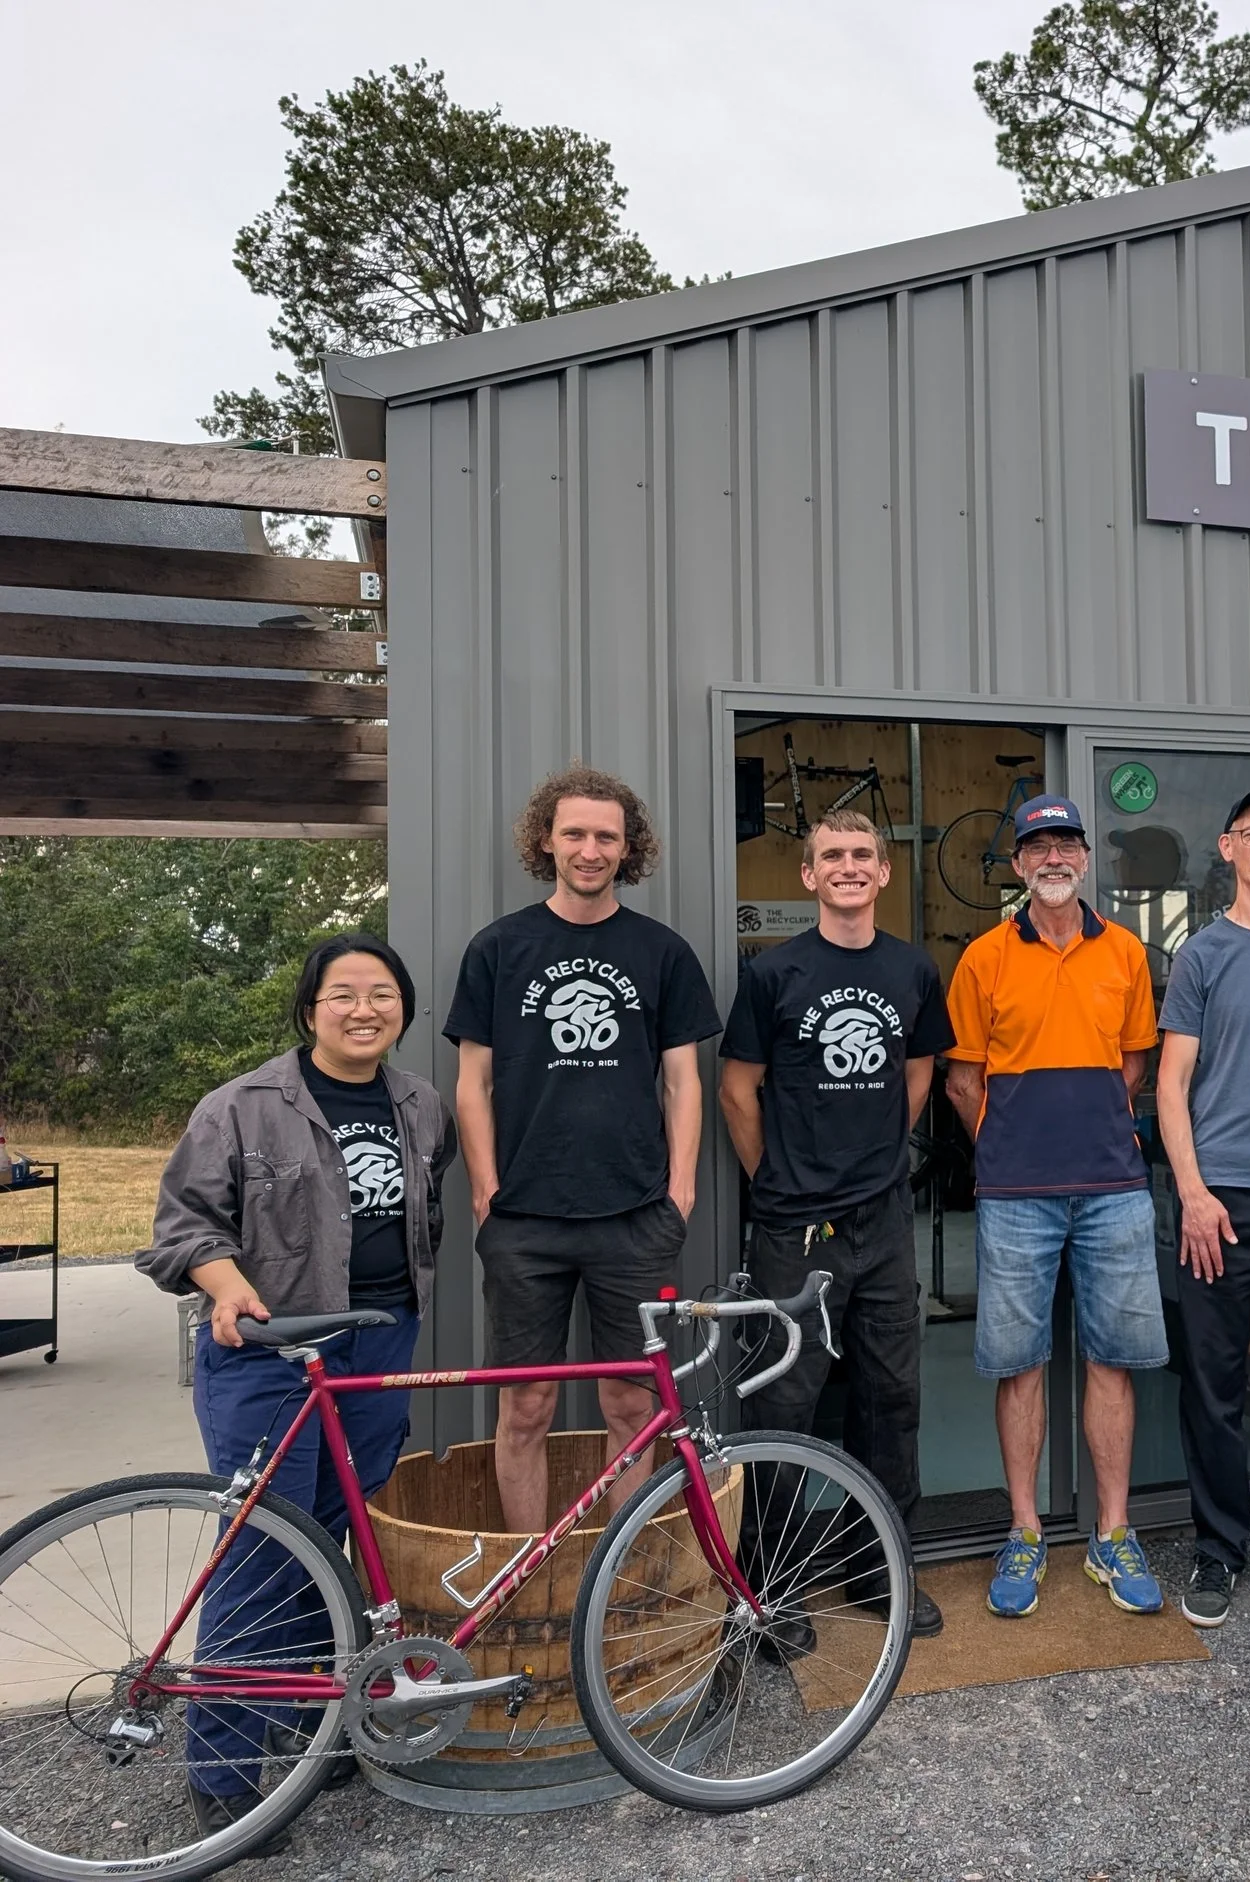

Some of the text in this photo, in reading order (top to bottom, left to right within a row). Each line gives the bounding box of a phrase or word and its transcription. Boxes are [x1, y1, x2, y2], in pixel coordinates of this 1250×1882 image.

[787, 748, 801, 803] CARRERA
[1112, 769, 1133, 793] GREEN
[1114, 772, 1139, 799] WHEELS
[1026, 808, 1069, 822] unisport
[767, 916, 816, 924] RECYCLERY
[521, 957, 641, 1017] THE RECYCLERY
[799, 987, 903, 1040] THE RECYCLERY
[582, 1060, 595, 1068] TO
[598, 1059, 619, 1067] RIDE
[818, 1082, 851, 1090] REBORN
[331, 1122, 400, 1147] RECYCLE
[207, 1527, 236, 1571] SHOGUN
[878, 1640, 894, 1680] ATLANTA
[103, 1855, 182, 1874] ATLANTA 1996
